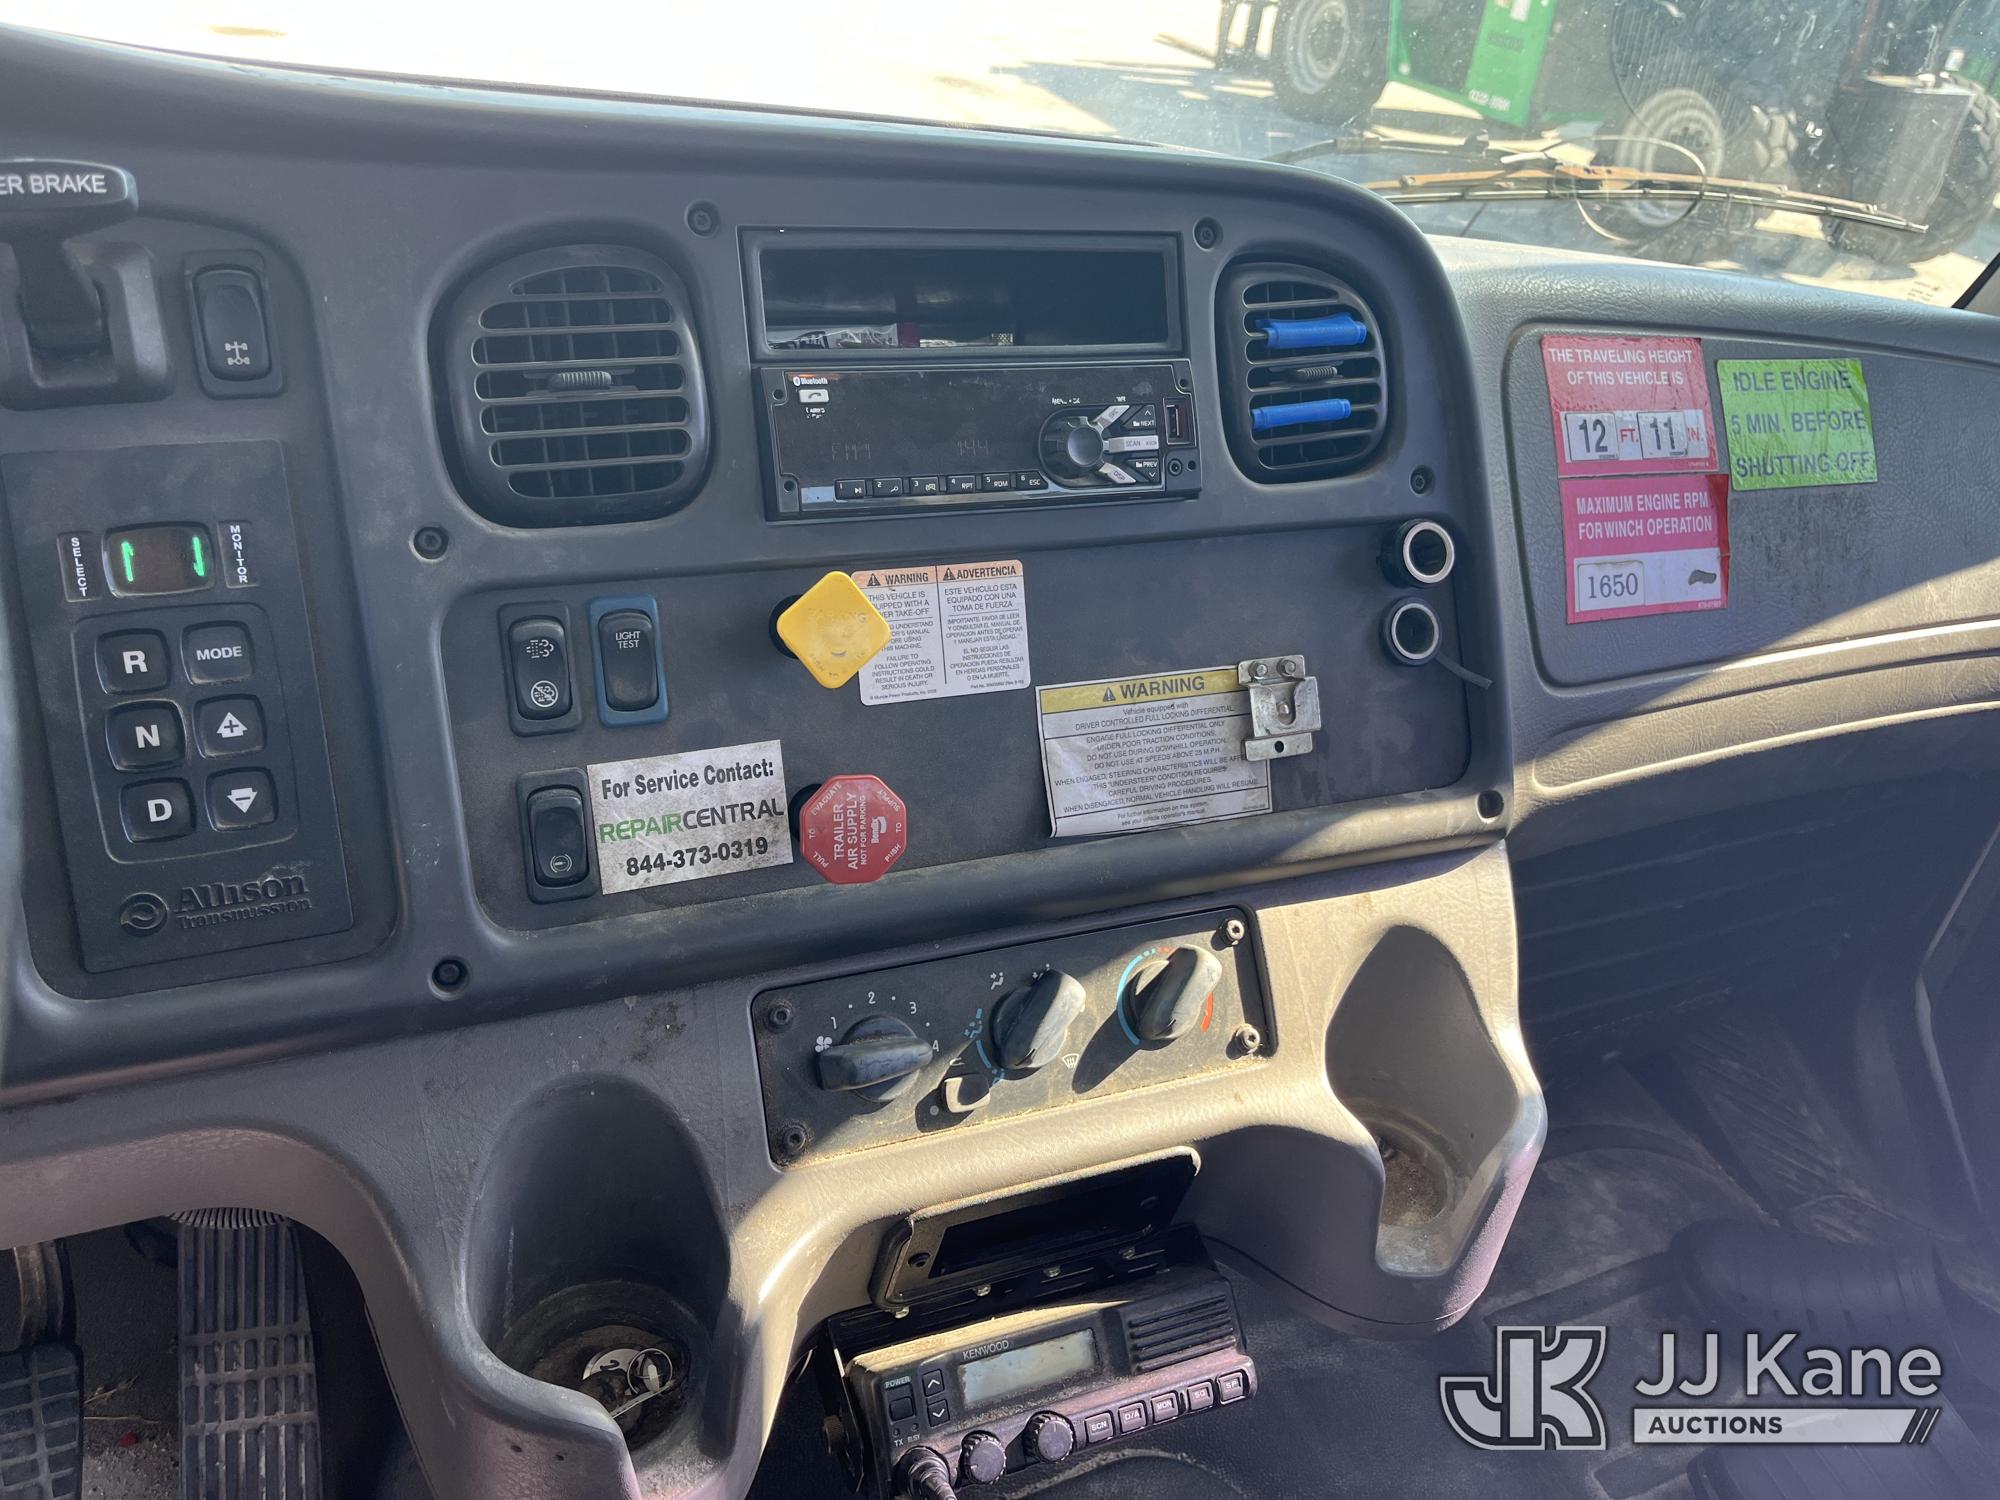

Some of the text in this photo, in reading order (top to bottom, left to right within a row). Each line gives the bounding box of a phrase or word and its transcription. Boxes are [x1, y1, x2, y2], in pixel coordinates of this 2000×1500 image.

[30, 174, 107, 193] BRAKE
[1550, 348, 1692, 363] THE TRAVELING HEIGHT
[1568, 371, 1684, 385] OF THIS VEHICLE IS
[1733, 370, 1852, 392] IDLE ENGINE
[1731, 410, 1866, 435] 5 MIN. BEFORE
[1579, 419, 1608, 453] 12
[1620, 428, 1639, 443] FT.
[1650, 417, 1675, 450] 11
[1736, 451, 1870, 478] SHUTTING OFF
[1576, 491, 1709, 515] MAXIMUM ENGINE RPM
[1578, 515, 1712, 540] FOR WINCH OPERATION
[229, 525, 248, 583] MONITOR
[71, 537, 89, 597] SELECT
[956, 565, 1016, 579] ADVERTENCIA
[885, 572, 928, 584] WARNING
[1588, 573, 1638, 599] 1650
[868, 593, 884, 601] THIS
[886, 591, 916, 600] VEHICLE
[944, 587, 961, 595] ESTE
[963, 584, 998, 593] VEHICULO
[946, 594, 982, 603] EQUIPADO
[1001, 591, 1016, 599] UNA
[904, 599, 922, 607] WITH
[985, 600, 1012, 609] FUERZA
[895, 608, 928, 616] TAKE-OFF
[615, 631, 641, 641] LIGHT
[617, 640, 640, 649] TEST
[196, 645, 243, 660] MODE
[122, 650, 148, 674] R
[1120, 675, 1205, 699] WARNING
[1122, 706, 1145, 715] Vehicle
[1146, 703, 1175, 713] equipped
[1075, 721, 1099, 730] DRIVER
[1101, 716, 1144, 727] CONTROLLED
[1144, 713, 1160, 722] FULL
[1161, 710, 1189, 719] LOCKING
[135, 724, 160, 748] N
[1086, 719, 1225, 743] ENGAGE FULL LOCKING DIFFERENTIAL ONLY
[1096, 742, 1120, 750] UNDER
[1122, 739, 1141, 747] POOR
[1142, 735, 1174, 745] TRACTION
[1128, 746, 1153, 755] DURING
[1155, 742, 1187, 752] DOWNHILL
[1144, 753, 1170, 762] SPEEDS
[1172, 750, 1192, 758] ABOVE
[601, 758, 774, 799] For Service Contact:
[1054, 778, 1074, 786] WHEN
[1108, 768, 1141, 778] STEERING
[1142, 760, 1202, 774] CHARACTERISTICS
[1157, 770, 1193, 780] CONDITION
[1108, 786, 1137, 796] CAREFUL
[1139, 782, 1165, 792] DRIVING
[810, 782, 842, 816] EVACUATE
[877, 789, 900, 812] SUPPLY
[147, 798, 173, 822] D
[600, 798, 784, 843] REPAIRCENTRAL
[896, 822, 902, 833] TO
[809, 828, 816, 839] TO
[833, 803, 845, 860] TRAILER
[846, 792, 858, 869] AIR SUPPLY
[626, 836, 768, 876] 844-373-0319
[813, 851, 829, 868] PULL
[884, 843, 901, 862] PUSH
[174, 874, 309, 913] Allison
[868, 991, 876, 1005] 2
[910, 1001, 917, 1014] 3
[830, 1016, 837, 1030] 1
[932, 1039, 939, 1052] 4
[963, 1340, 1009, 1360] KENWOOD
[885, 1375, 911, 1389] POWER
[894, 1438, 903, 1447] TX
